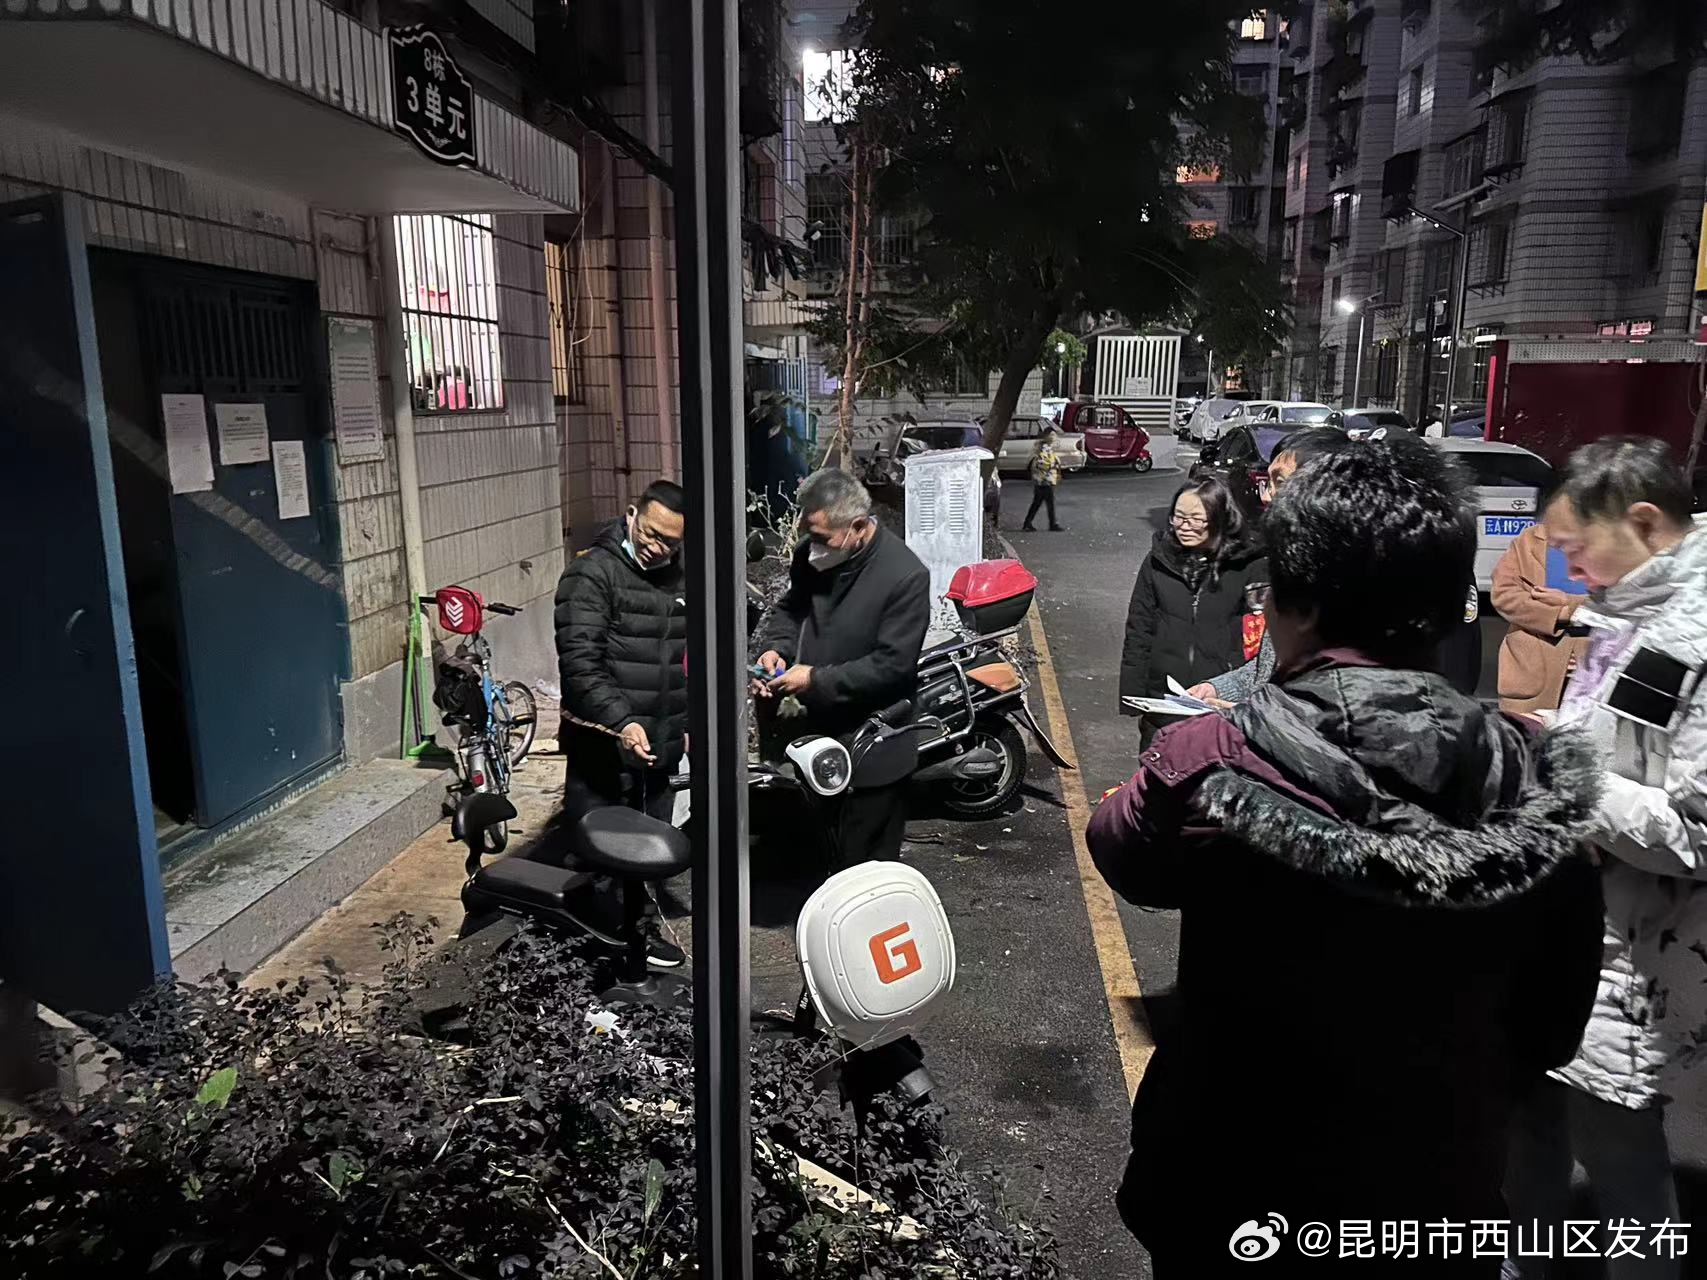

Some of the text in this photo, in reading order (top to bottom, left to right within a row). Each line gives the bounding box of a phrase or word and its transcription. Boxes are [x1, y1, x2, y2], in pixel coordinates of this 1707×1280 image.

[424, 48, 446, 81] 8栋
[406, 75, 466, 140] 3单元
[869, 921, 922, 985] G
